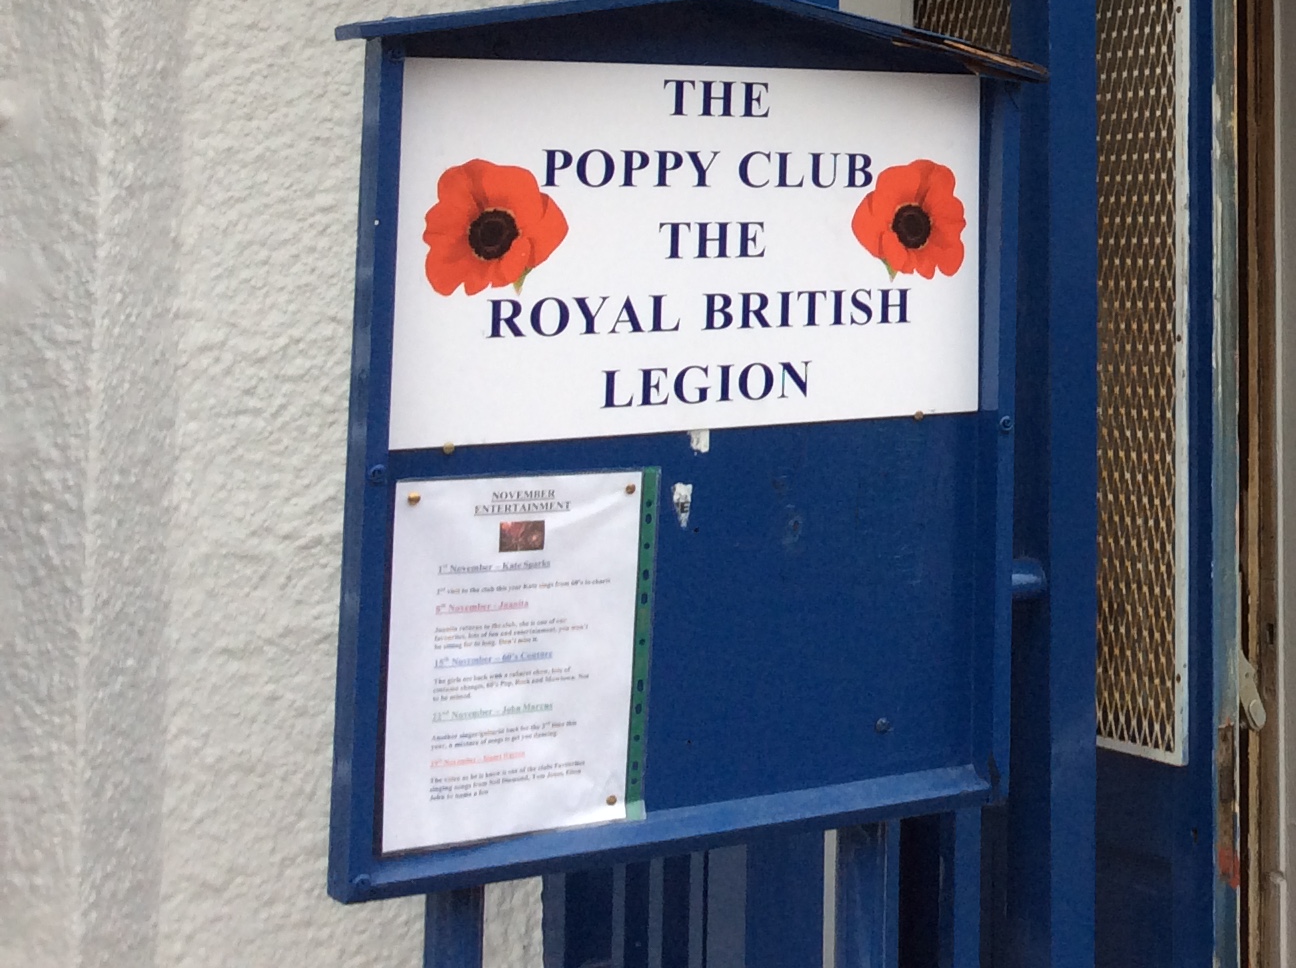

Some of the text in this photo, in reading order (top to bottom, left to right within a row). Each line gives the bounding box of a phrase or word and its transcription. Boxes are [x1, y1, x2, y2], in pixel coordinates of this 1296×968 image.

[664, 79, 770, 119] THE
[542, 148, 874, 189] POPPY CLUB
[659, 221, 766, 259] THE
[486, 288, 912, 339] ROYAL BRITISH
[601, 361, 812, 408] LEGION
[492, 488, 554, 500] NOVEMBER
[474, 500, 570, 514] ENTERTAINMENT
[450, 562, 492, 573] November
[448, 601, 490, 613] November
[452, 654, 491, 666] November
[451, 707, 492, 719] November
